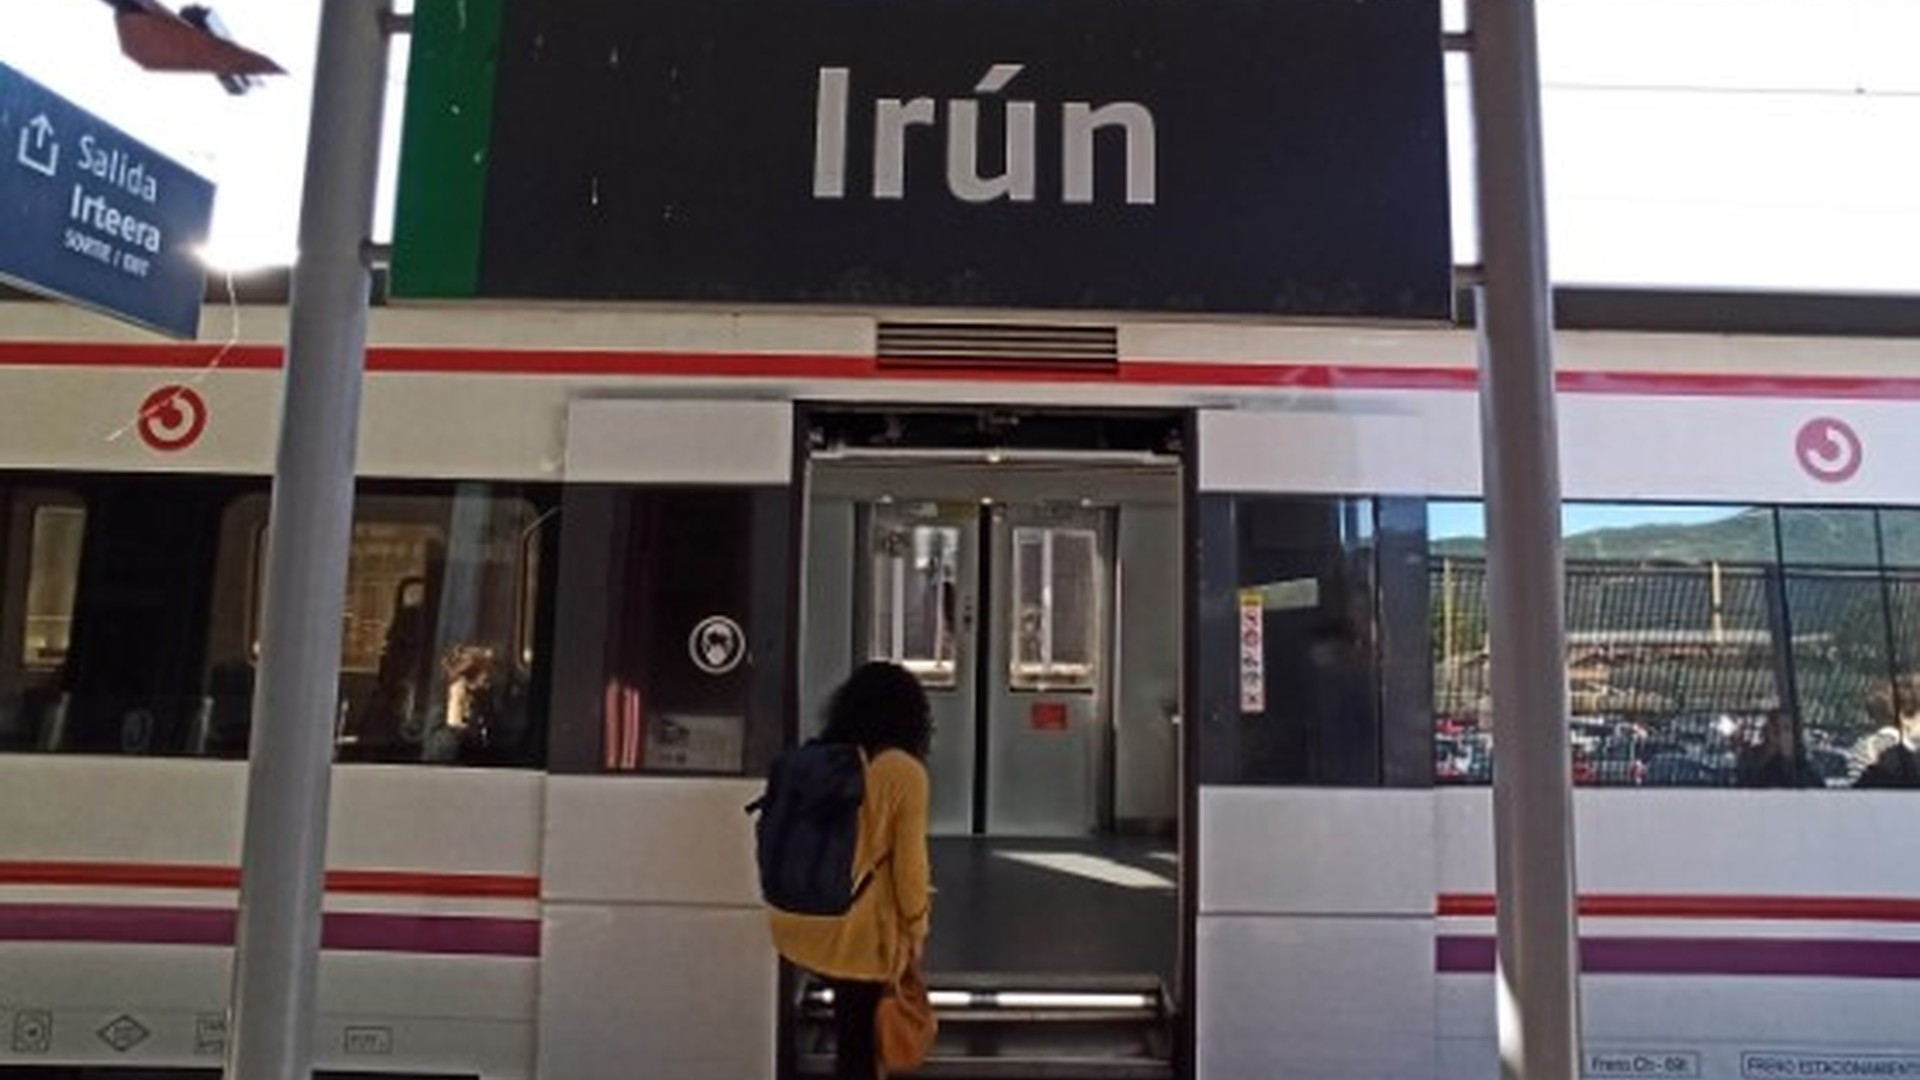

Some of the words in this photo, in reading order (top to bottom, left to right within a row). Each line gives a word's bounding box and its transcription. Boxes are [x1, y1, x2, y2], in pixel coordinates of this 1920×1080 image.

[77, 134, 158, 203] Salida
[813, 63, 1156, 204] Irún
[70, 183, 161, 253] Irteera
